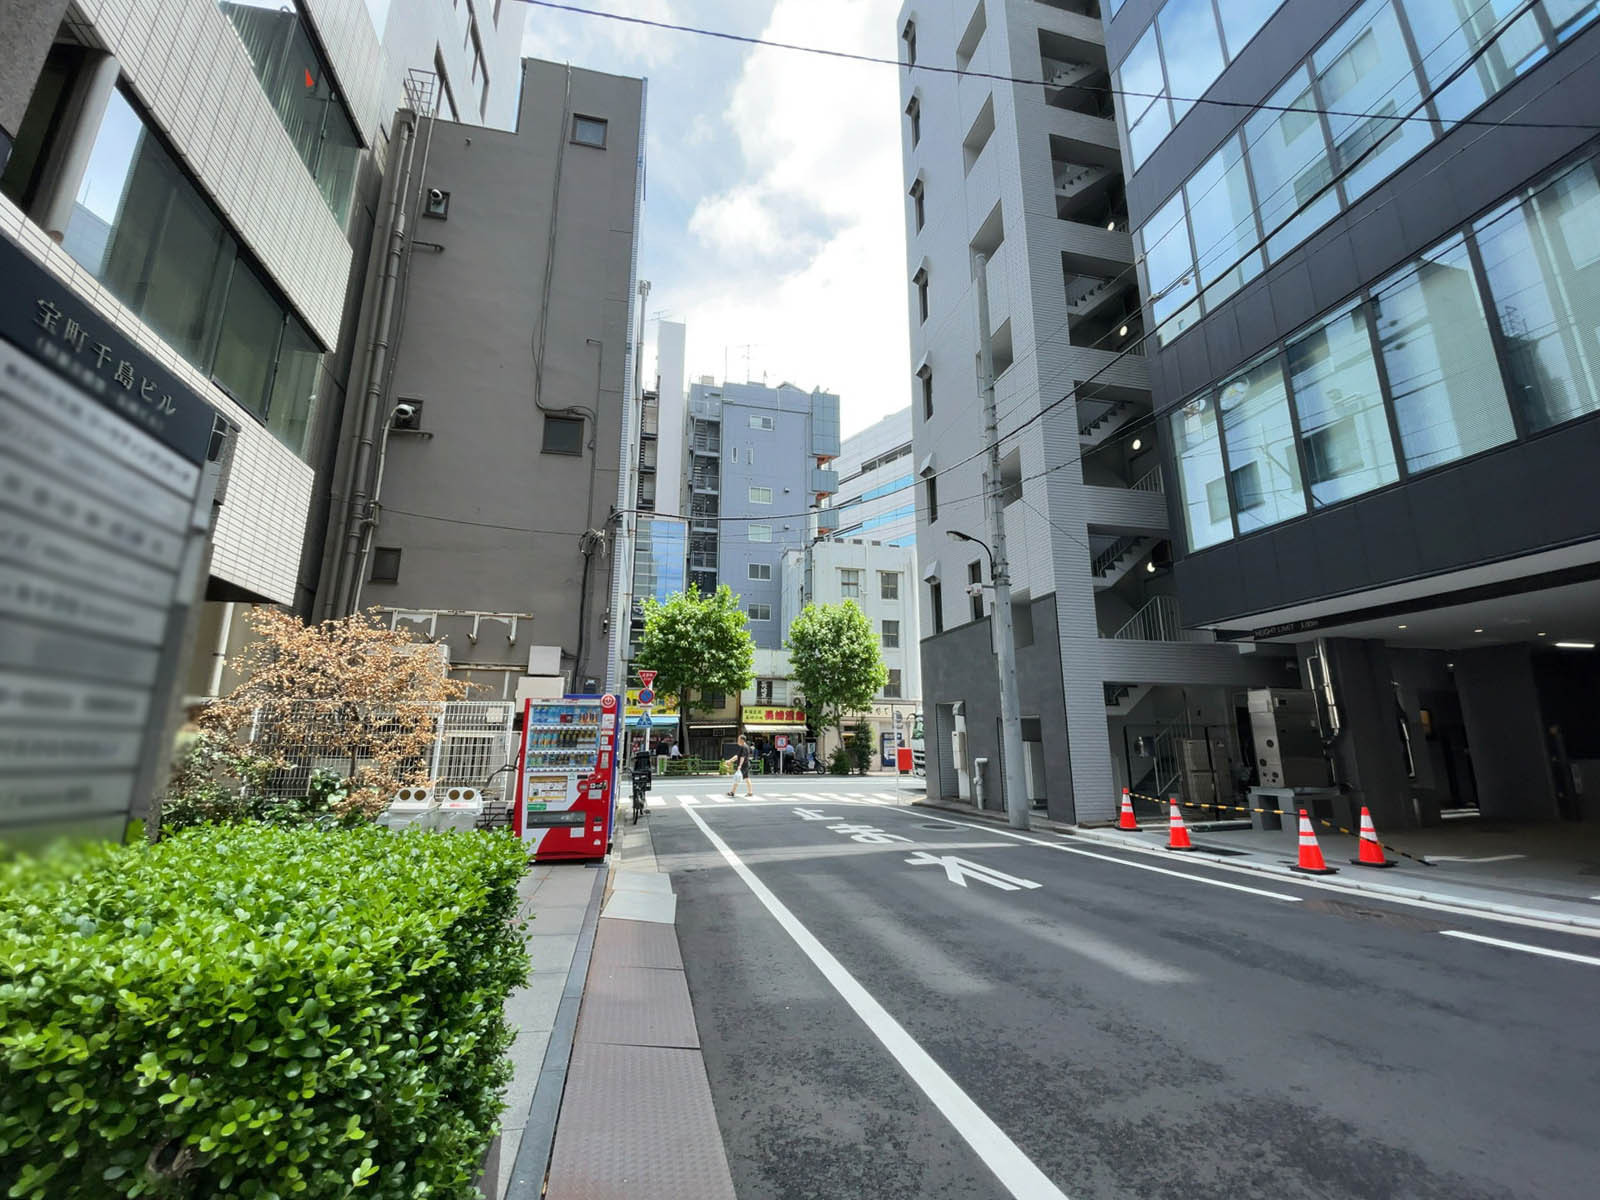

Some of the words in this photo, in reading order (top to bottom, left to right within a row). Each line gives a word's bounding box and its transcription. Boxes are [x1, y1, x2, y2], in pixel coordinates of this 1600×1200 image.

[33, 299, 176, 415] 宝町千島ビル
[792, 807, 1043, 890] 止まれ
